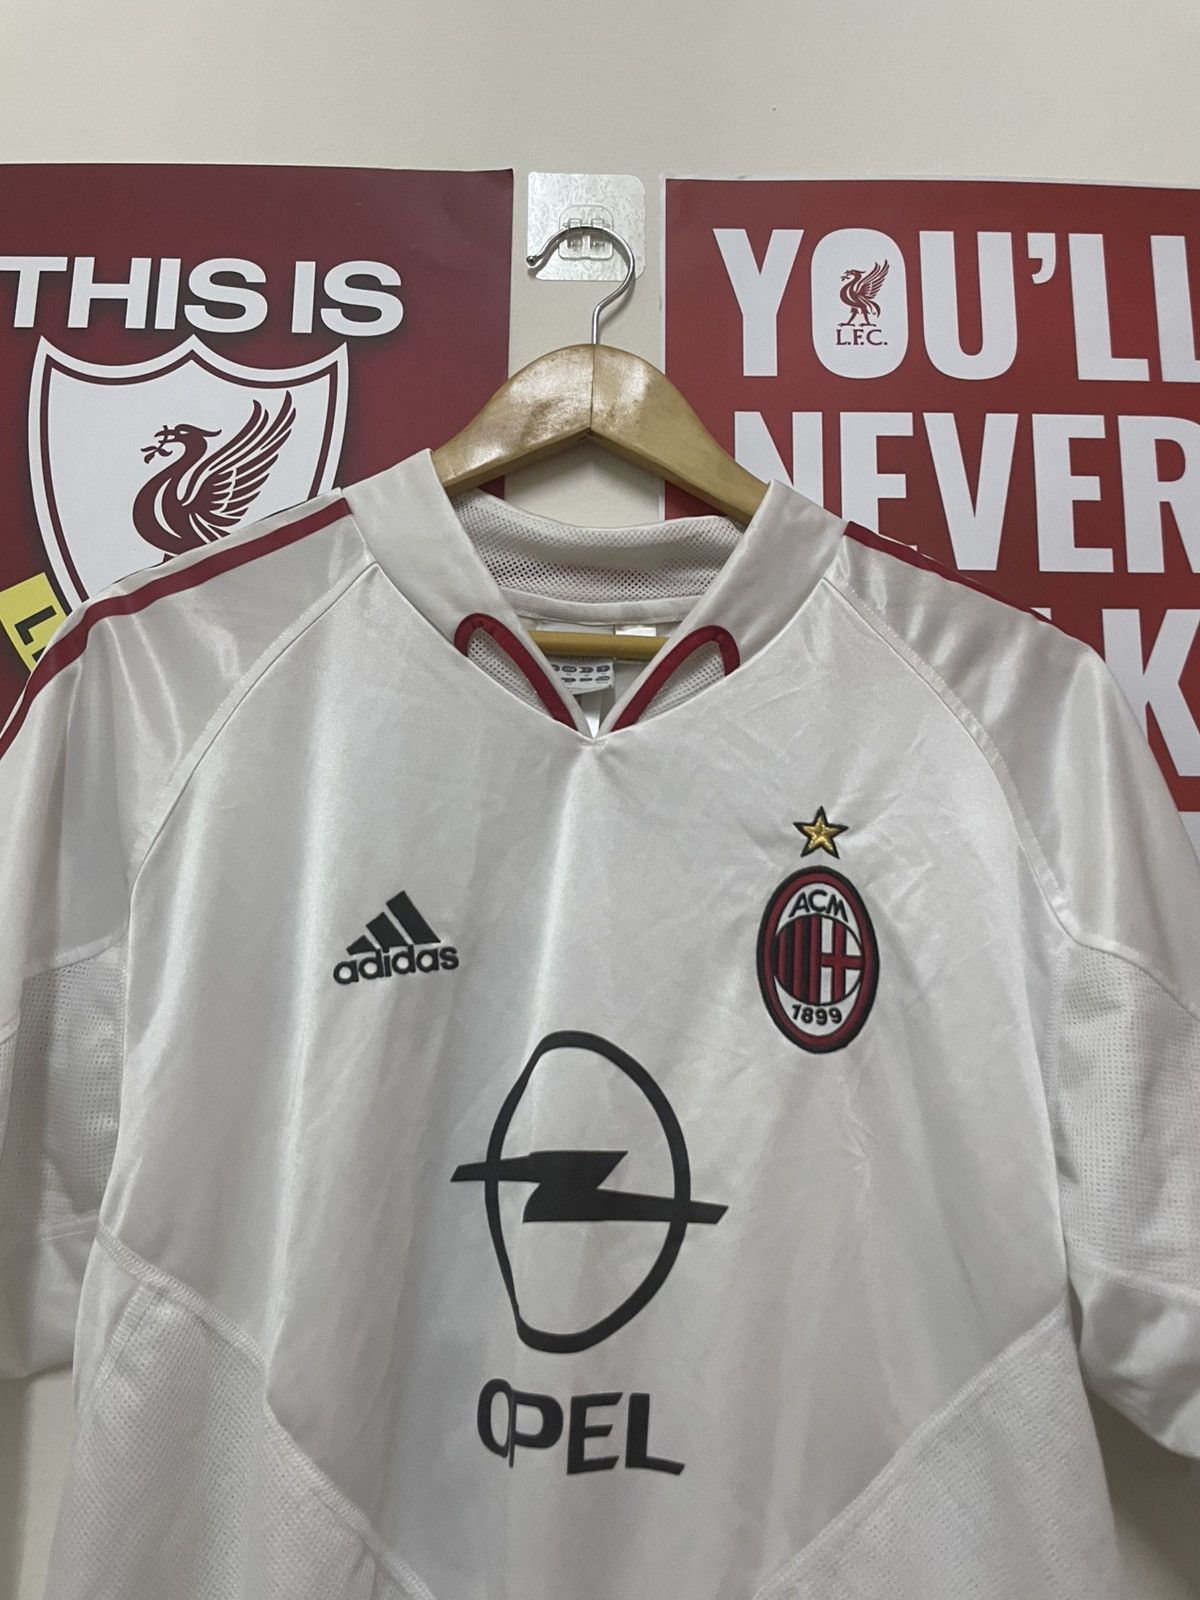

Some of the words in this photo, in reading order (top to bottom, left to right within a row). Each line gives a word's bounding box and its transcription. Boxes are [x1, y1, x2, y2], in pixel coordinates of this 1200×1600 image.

[0, 256, 268, 333] THIS
[291, 261, 404, 337] IS
[836, 329, 888, 346] L.F.C.
[788, 889, 848, 923] ACM
[333, 944, 460, 985] adidas
[791, 1004, 842, 1026] 1899
[477, 1378, 685, 1476] OPEL
